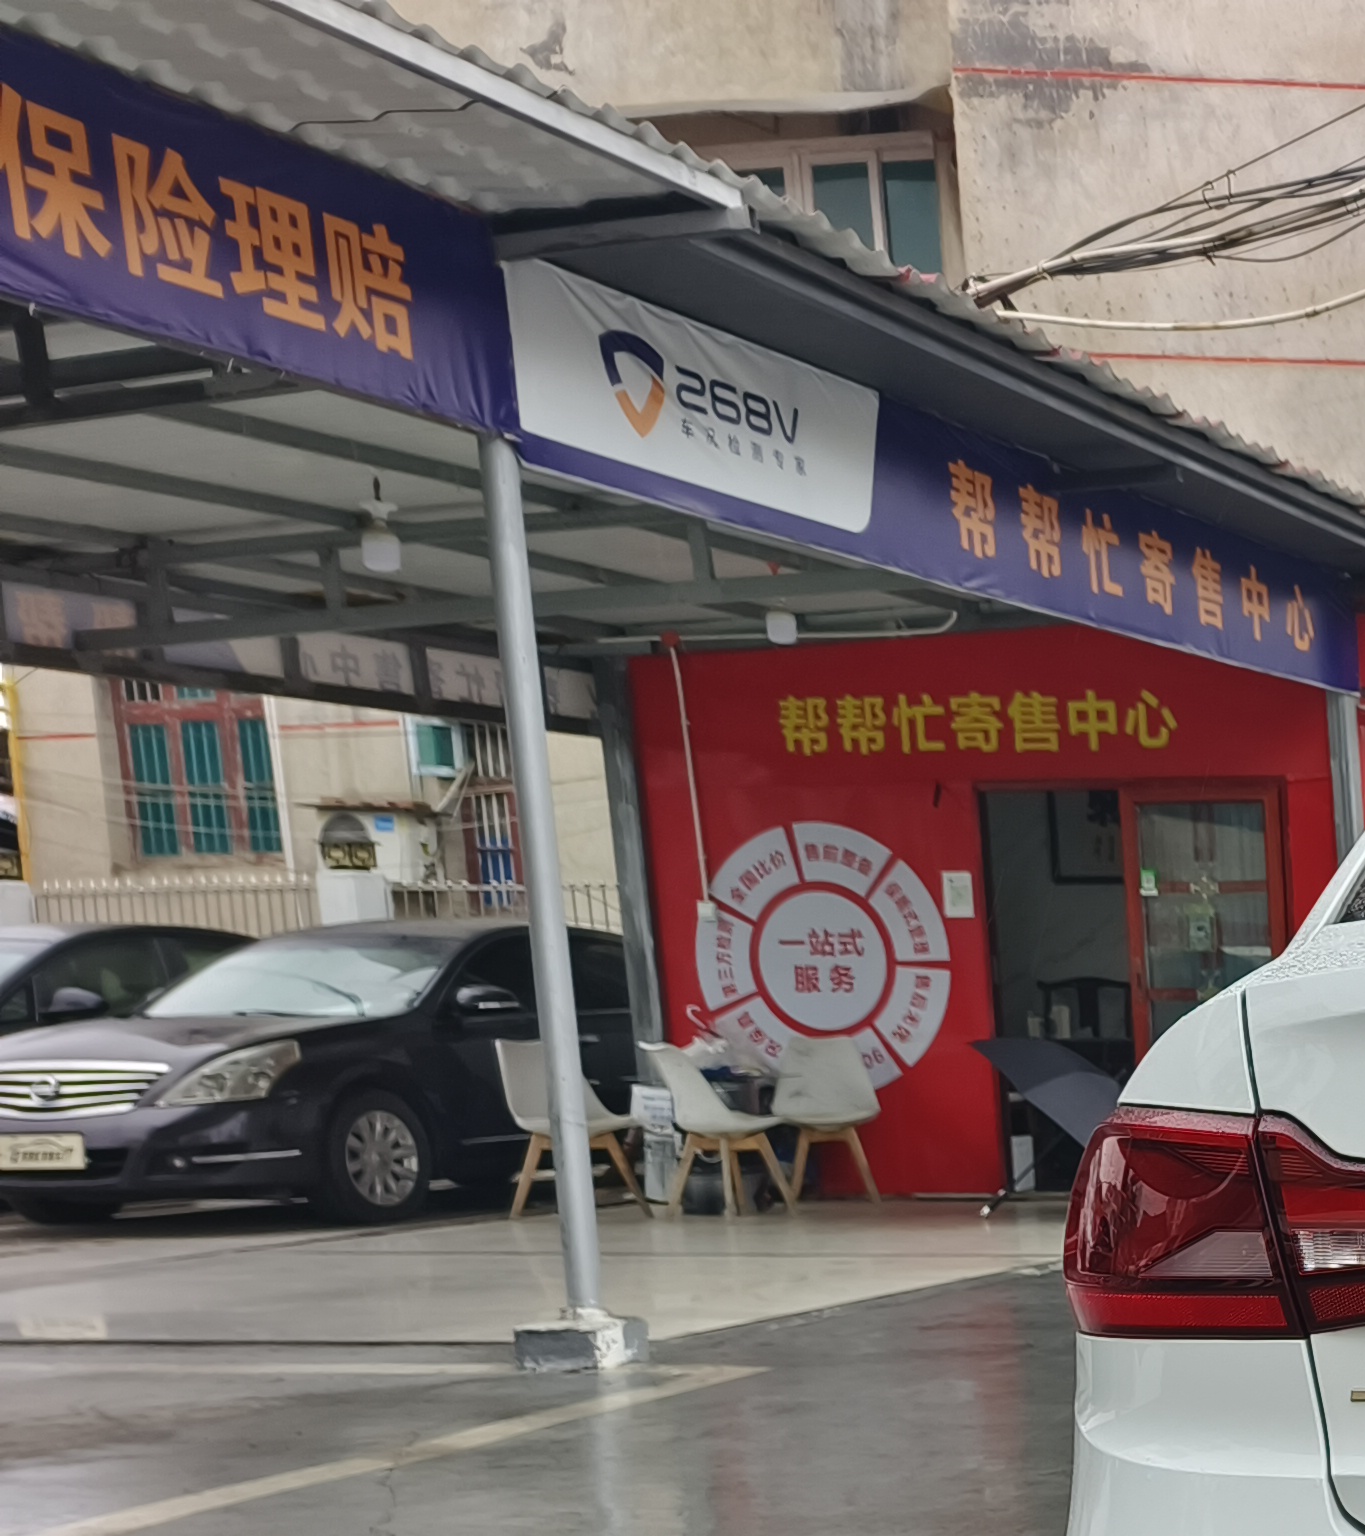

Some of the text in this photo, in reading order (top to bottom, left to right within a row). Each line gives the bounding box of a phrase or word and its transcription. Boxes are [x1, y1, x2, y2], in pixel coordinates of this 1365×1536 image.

[0, 82, 414, 361] 保险理赔
[675, 364, 799, 445] 268V
[948, 459, 1316, 652] 帮帮忙寄售中心
[778, 689, 1178, 756] 帮帮忙寄售中心
[778, 928, 866, 958] 一站式
[794, 965, 855, 994] 服务
